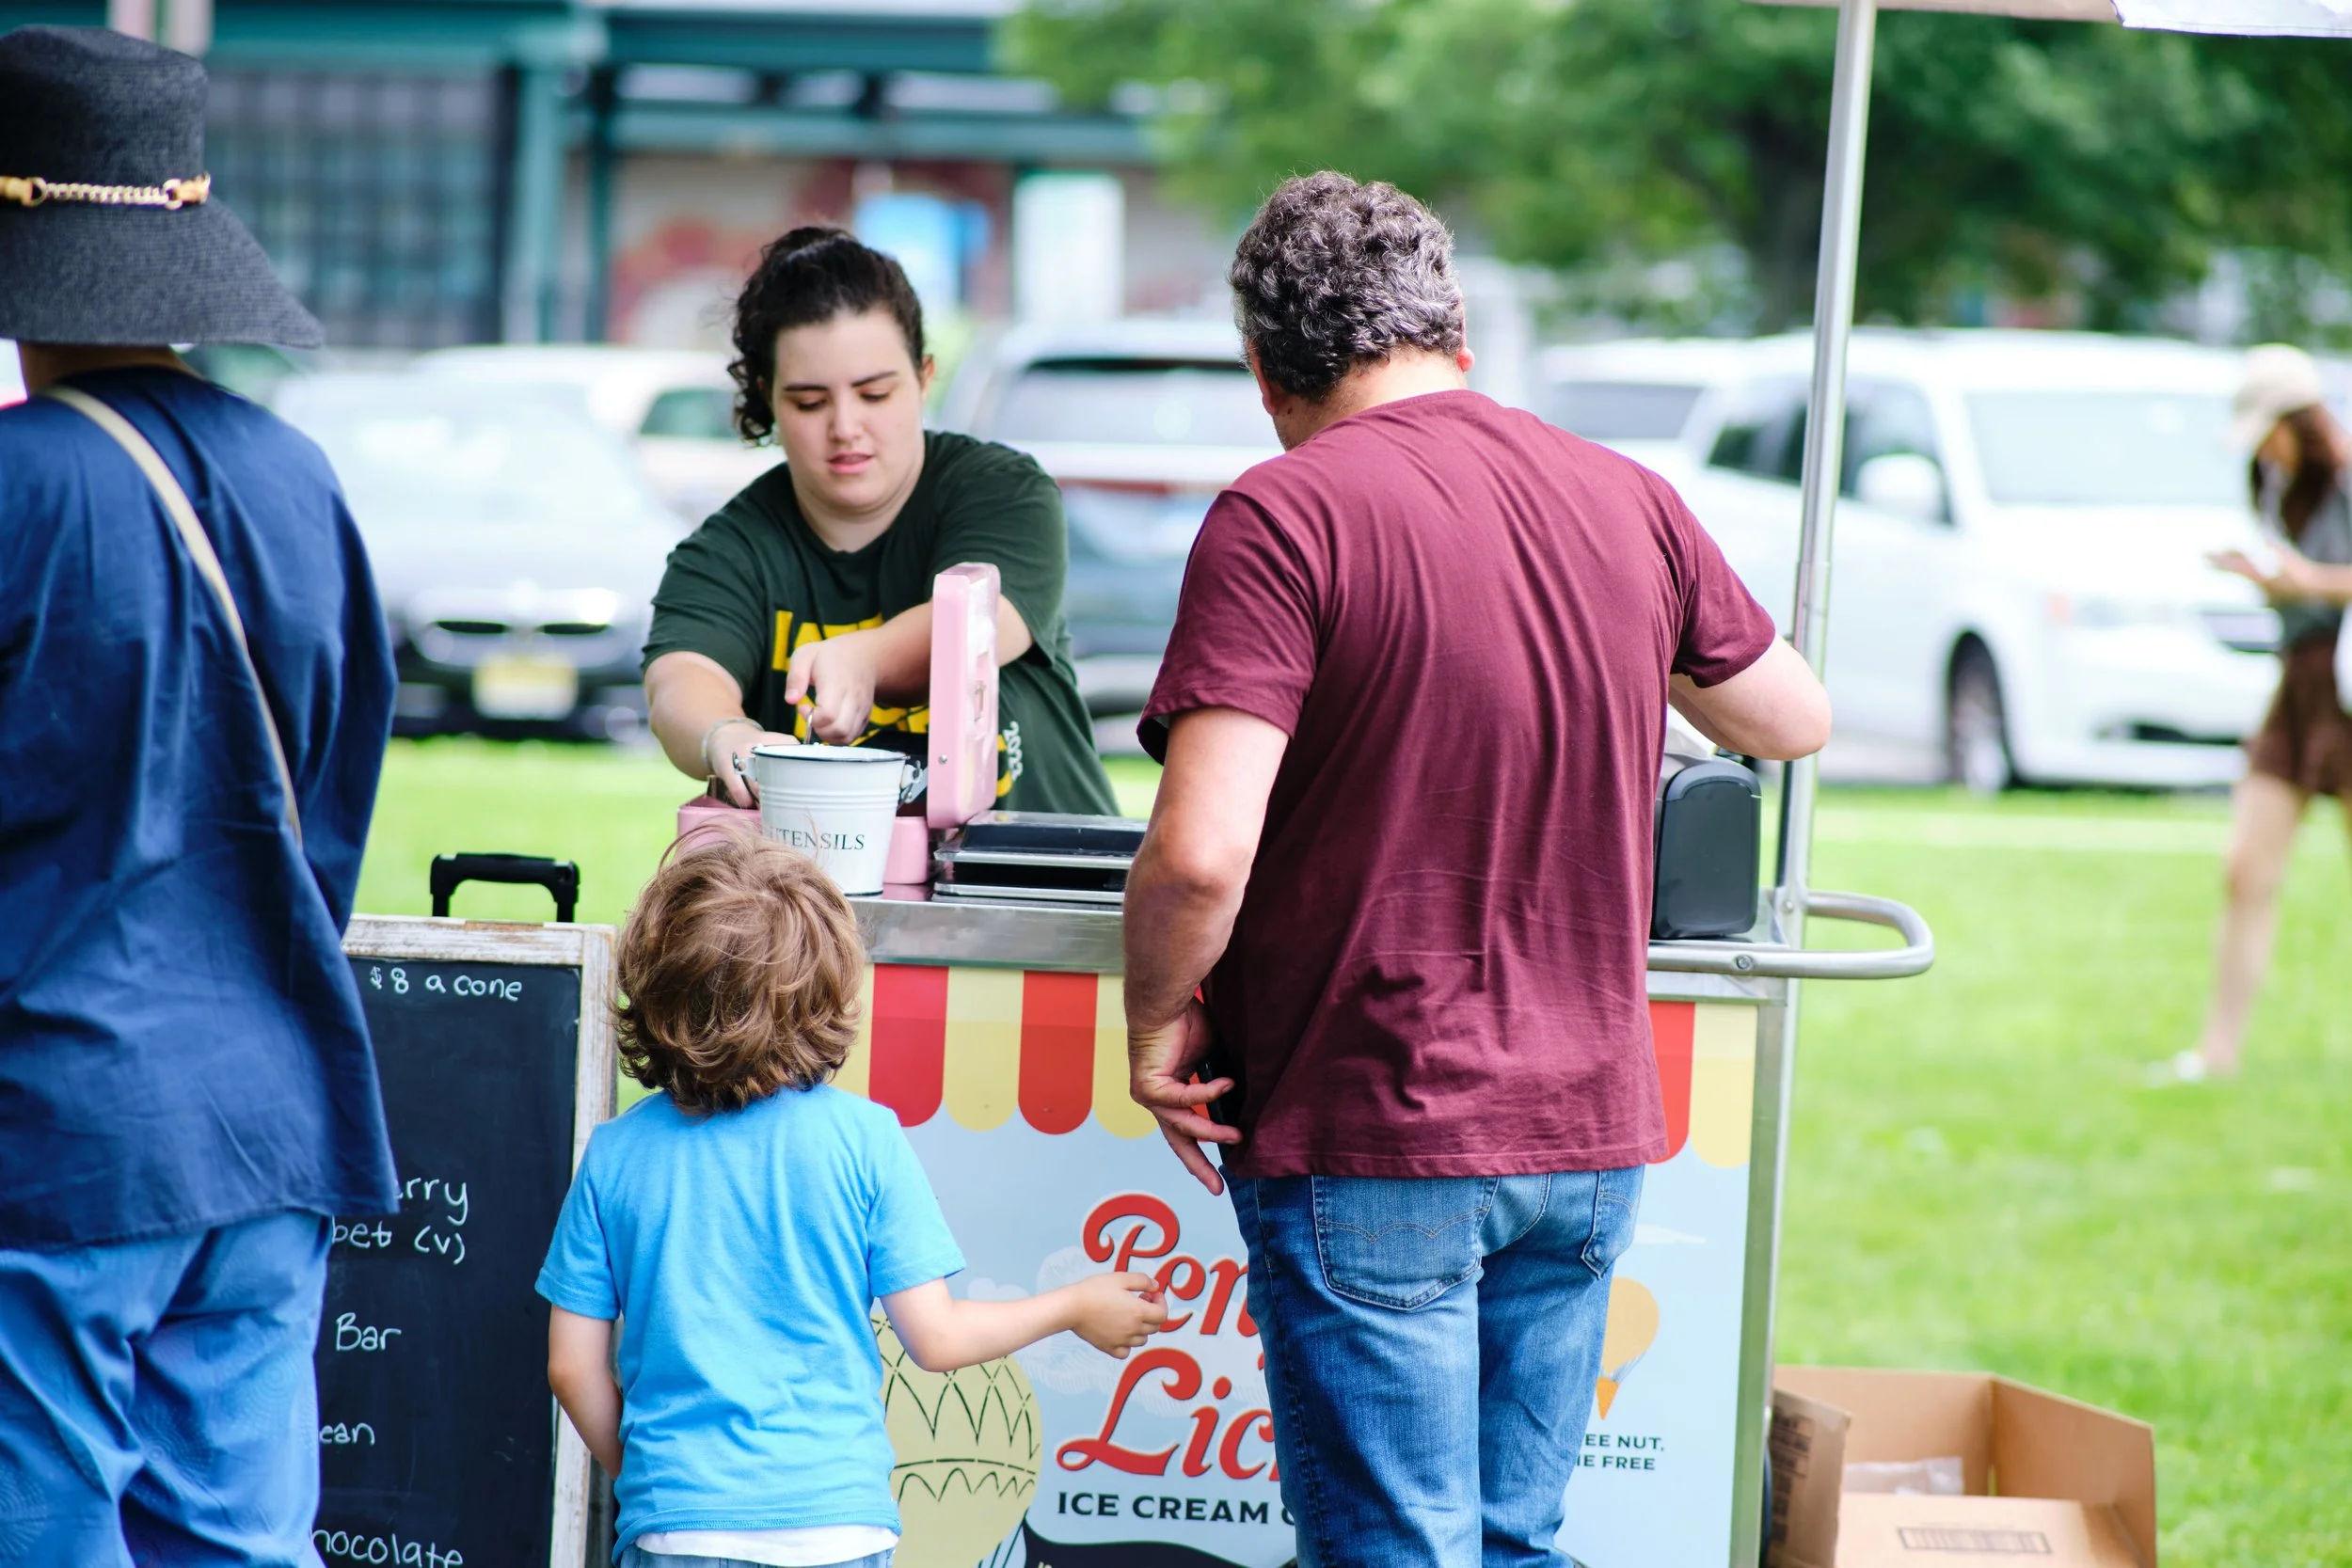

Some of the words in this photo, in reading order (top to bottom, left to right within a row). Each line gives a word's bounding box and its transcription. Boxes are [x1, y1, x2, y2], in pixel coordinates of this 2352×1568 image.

[369, 966, 409, 994] $8
[425, 974, 447, 994] a
[453, 976, 522, 1002] cone
[414, 1226, 466, 1265] (v)
[335, 1312, 402, 1352] Bar
[1056, 1347, 1280, 1481] Lic
[320, 1423, 375, 1446] ean
[1584, 1433, 1611, 1448] EE
[1617, 1435, 1663, 1451] NUT,
[1601, 1455, 1656, 1470] FREE
[1058, 1491, 1120, 1517] ICE
[1132, 1496, 1270, 1525] CREAM
